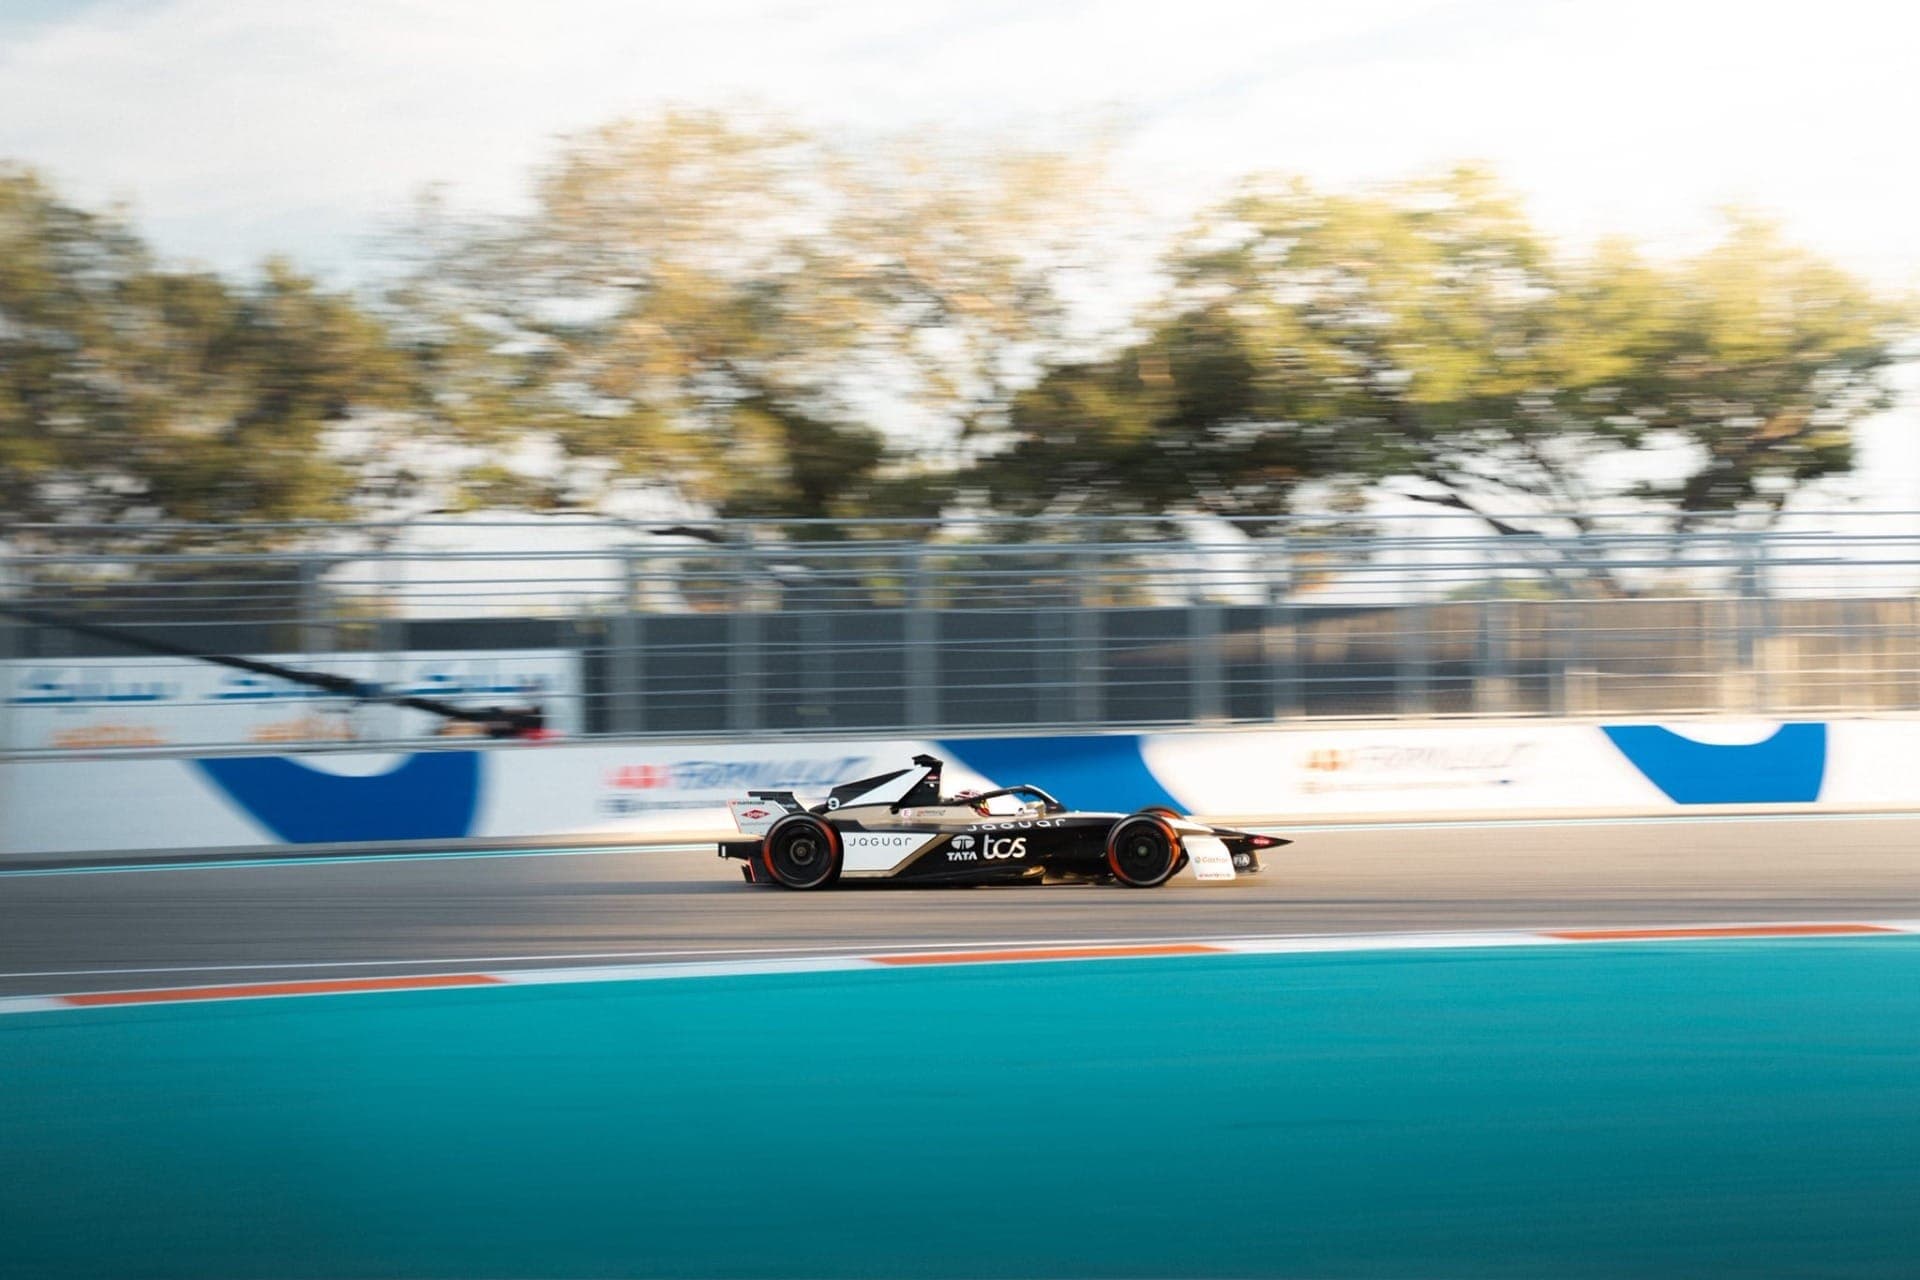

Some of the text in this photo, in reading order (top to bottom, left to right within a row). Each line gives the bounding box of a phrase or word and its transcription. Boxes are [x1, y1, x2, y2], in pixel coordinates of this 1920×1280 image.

[827, 797, 840, 811] 9
[983, 834, 1027, 860] tcs
[946, 851, 978, 861] TATA
